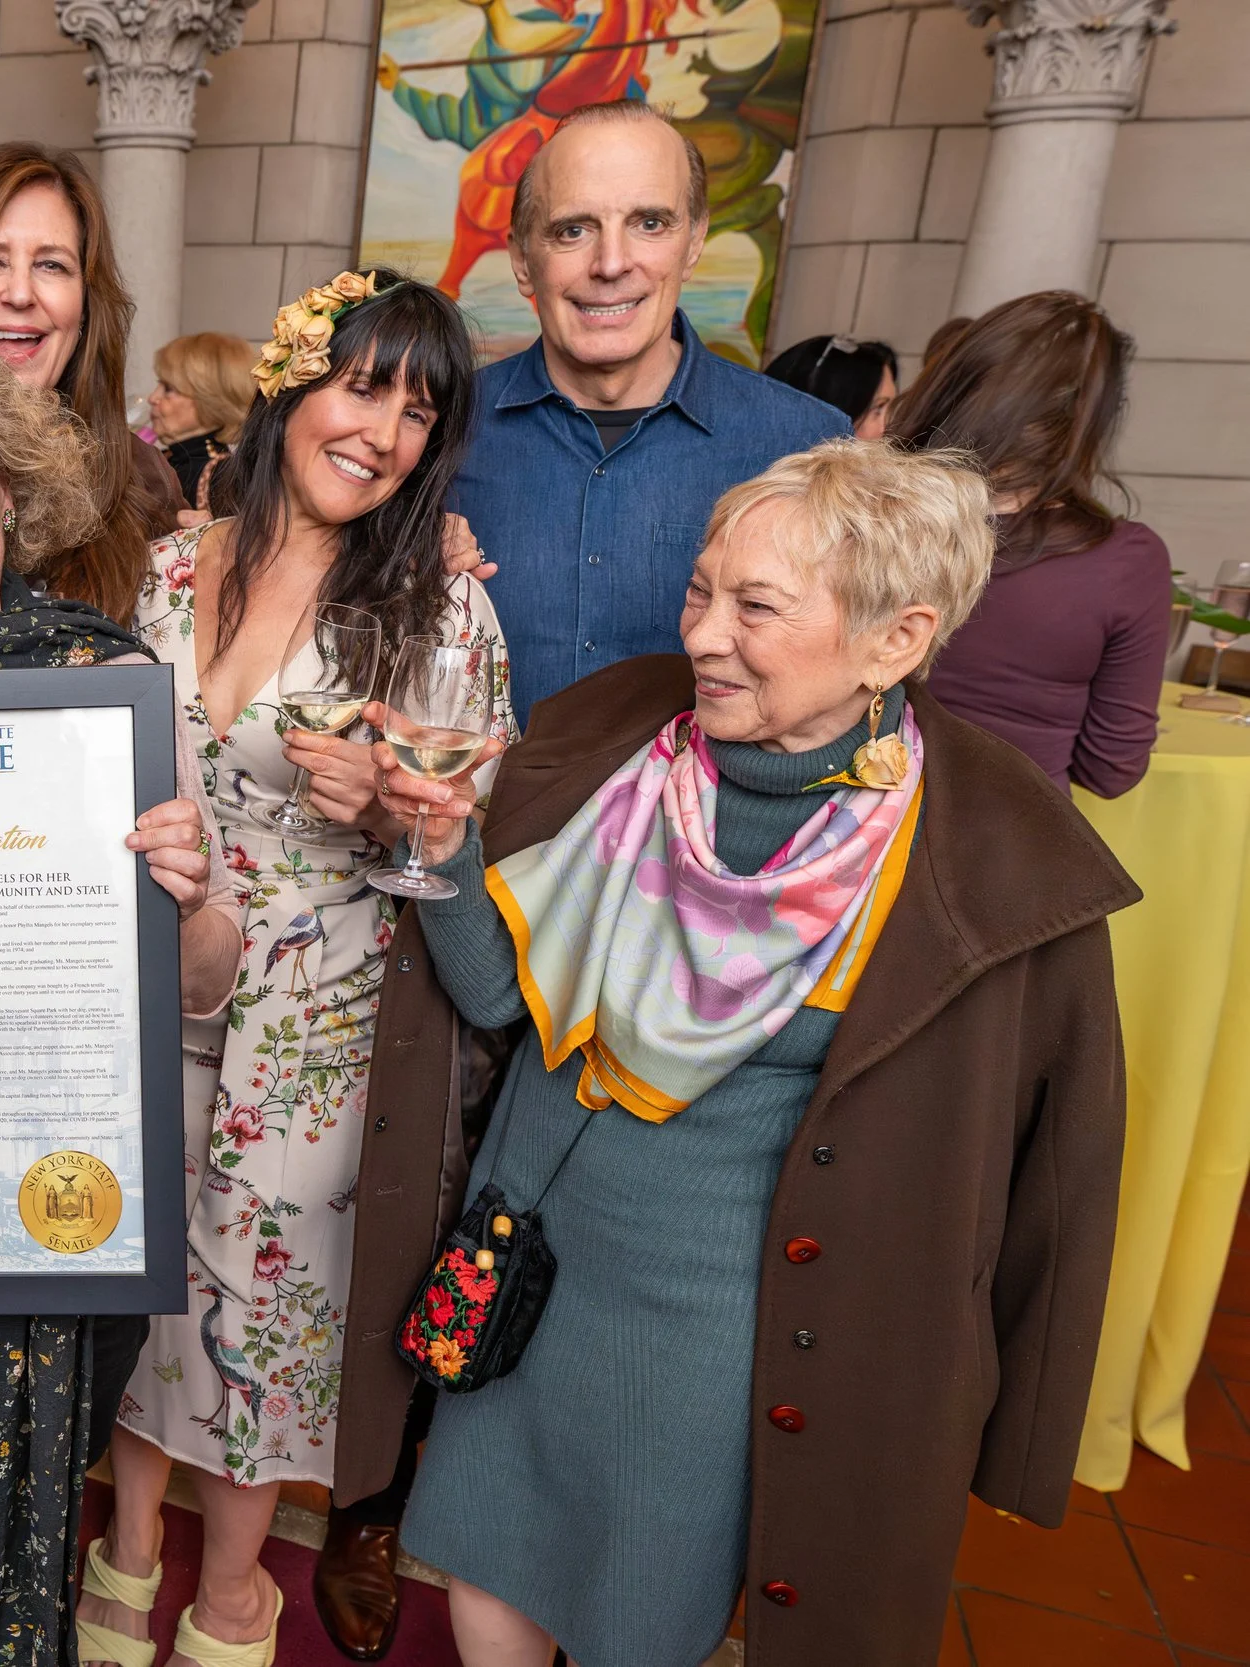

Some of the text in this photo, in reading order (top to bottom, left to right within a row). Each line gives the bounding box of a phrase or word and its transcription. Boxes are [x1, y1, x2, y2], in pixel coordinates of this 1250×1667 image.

[19, 873, 43, 883] FOR
[46, 872, 71, 882] HER
[46, 886, 73, 896] AND
[76, 885, 110, 895] STATE
[26, 1155, 116, 1191] NEW YORK STATE
[48, 1236, 94, 1250] SENATE
